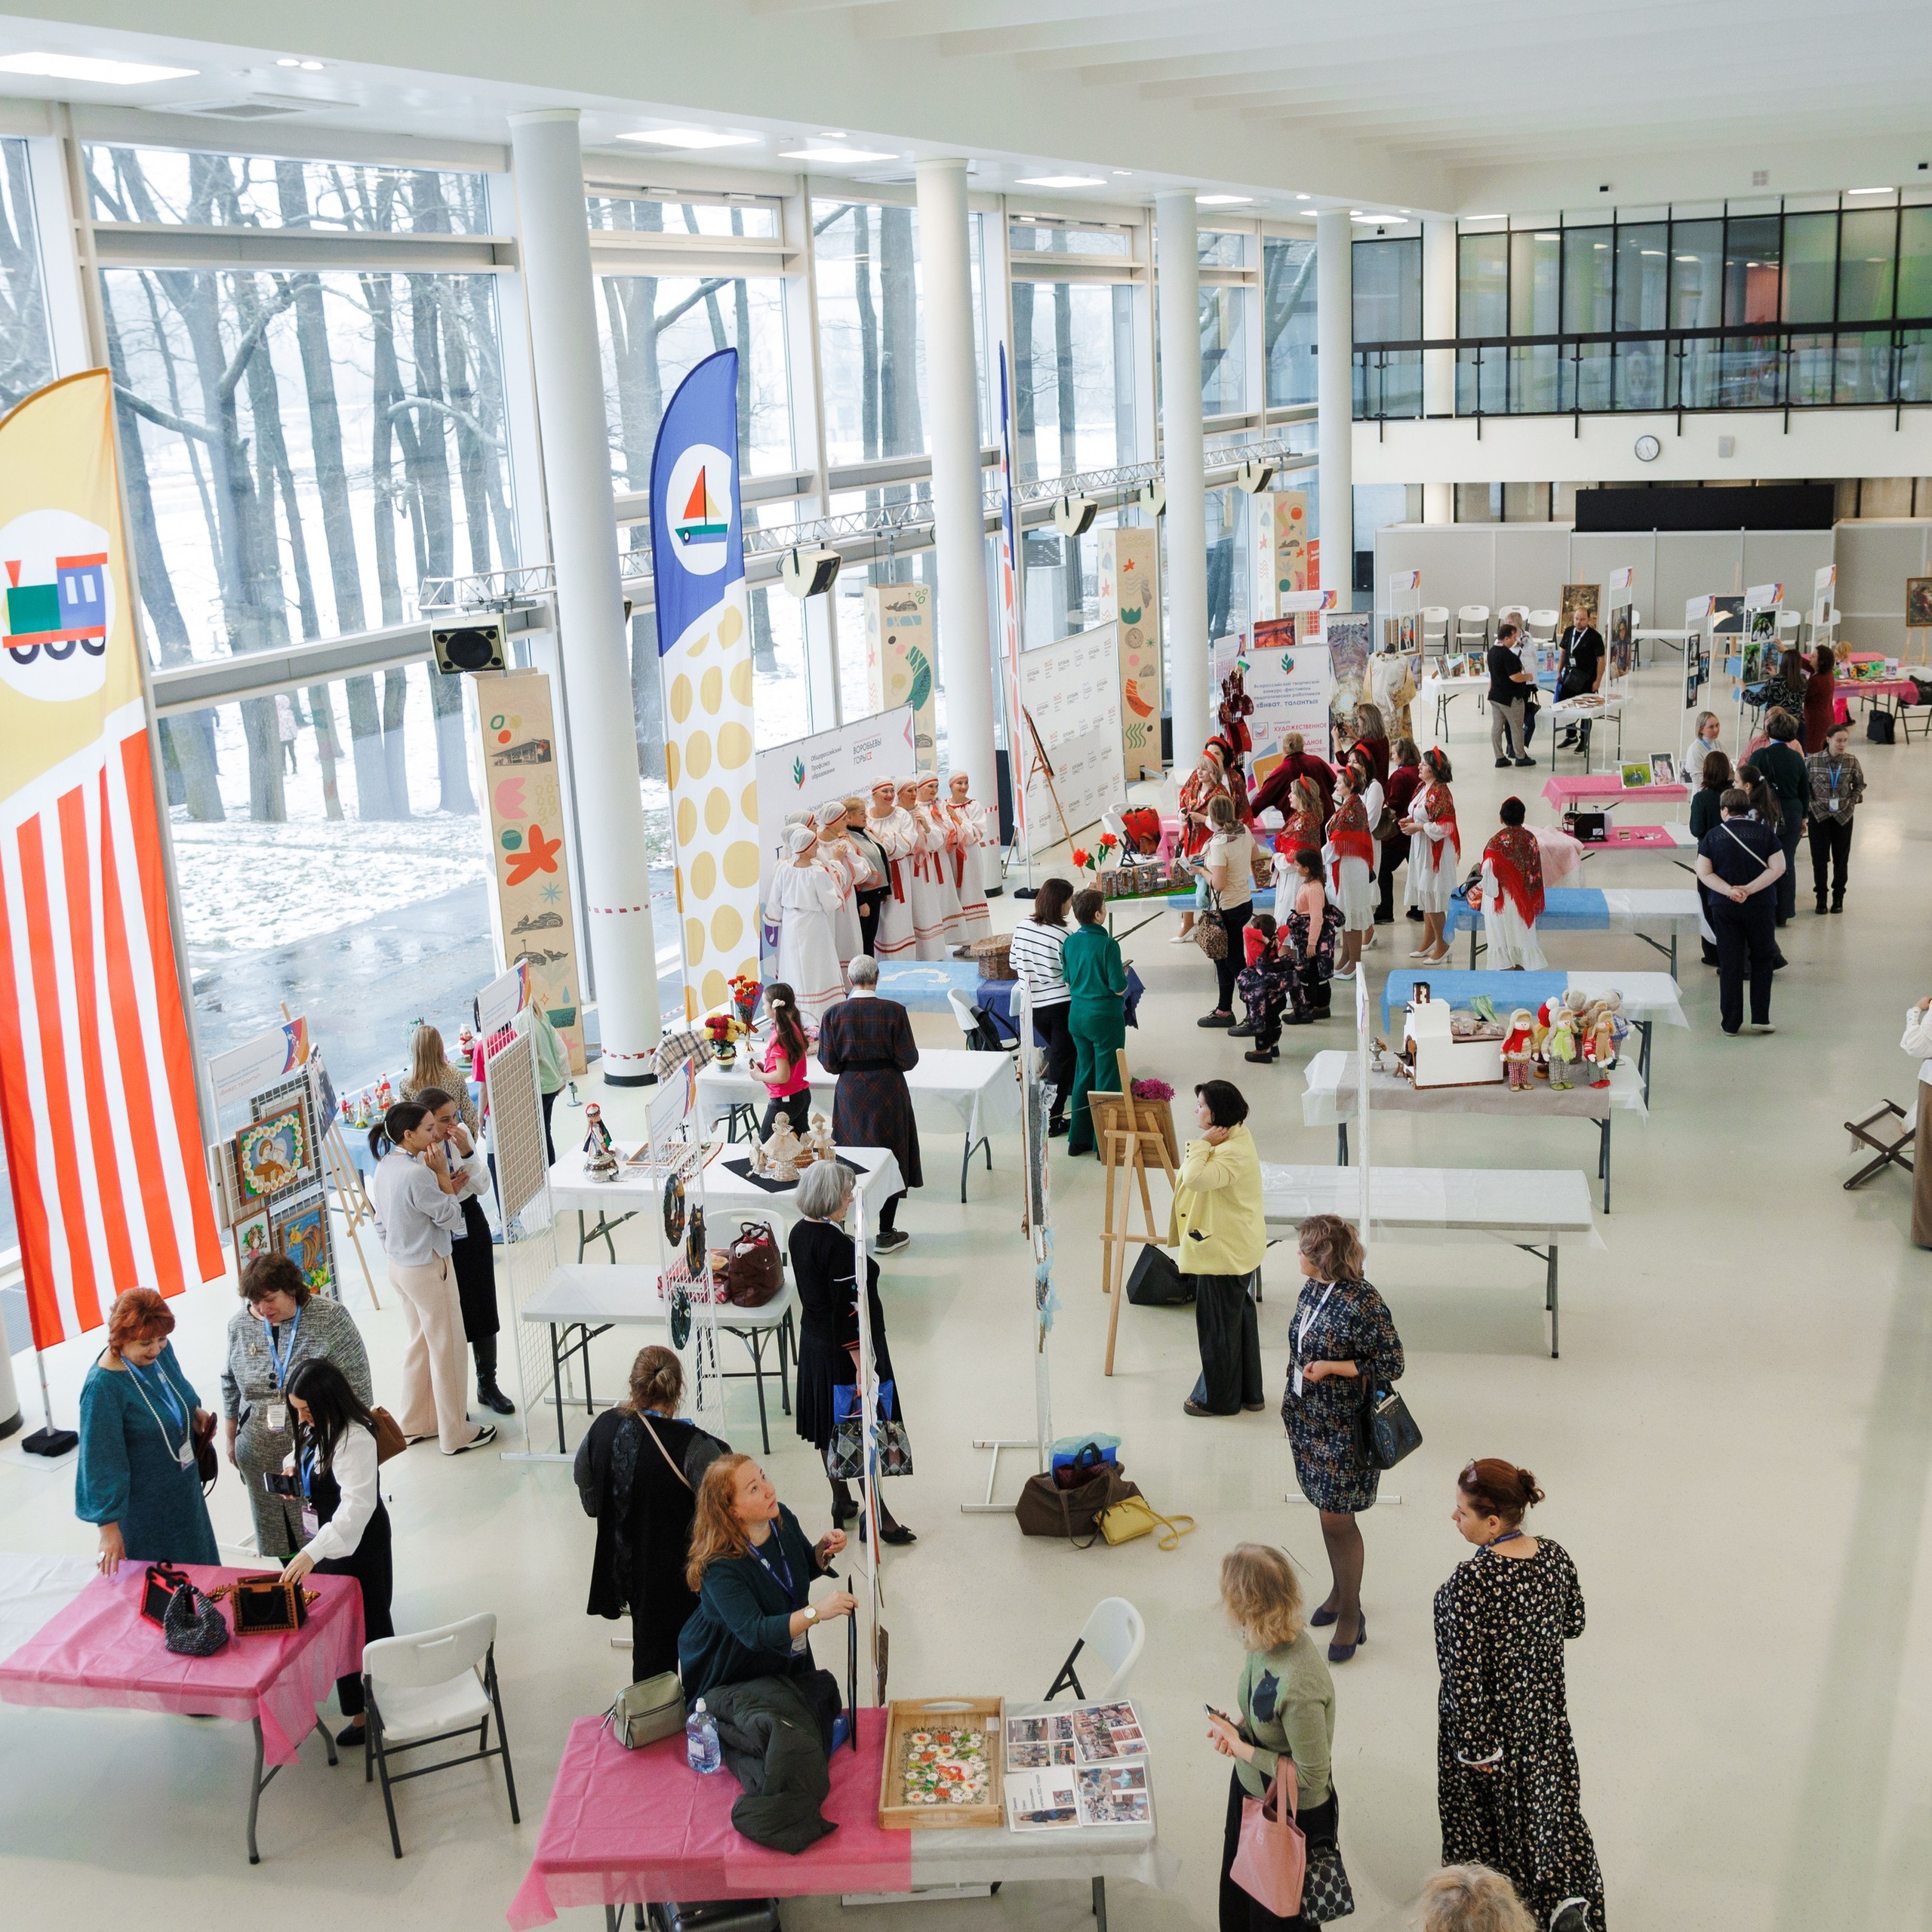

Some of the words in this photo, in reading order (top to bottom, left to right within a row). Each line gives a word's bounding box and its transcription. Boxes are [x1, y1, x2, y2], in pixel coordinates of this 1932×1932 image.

[1273, 723, 1327, 732] ХУДОЖЕСТВЕННОЕ
[853, 738, 881, 755] ВОРОБЬЕВЫ
[854, 753, 867, 765] ГОРЫ
